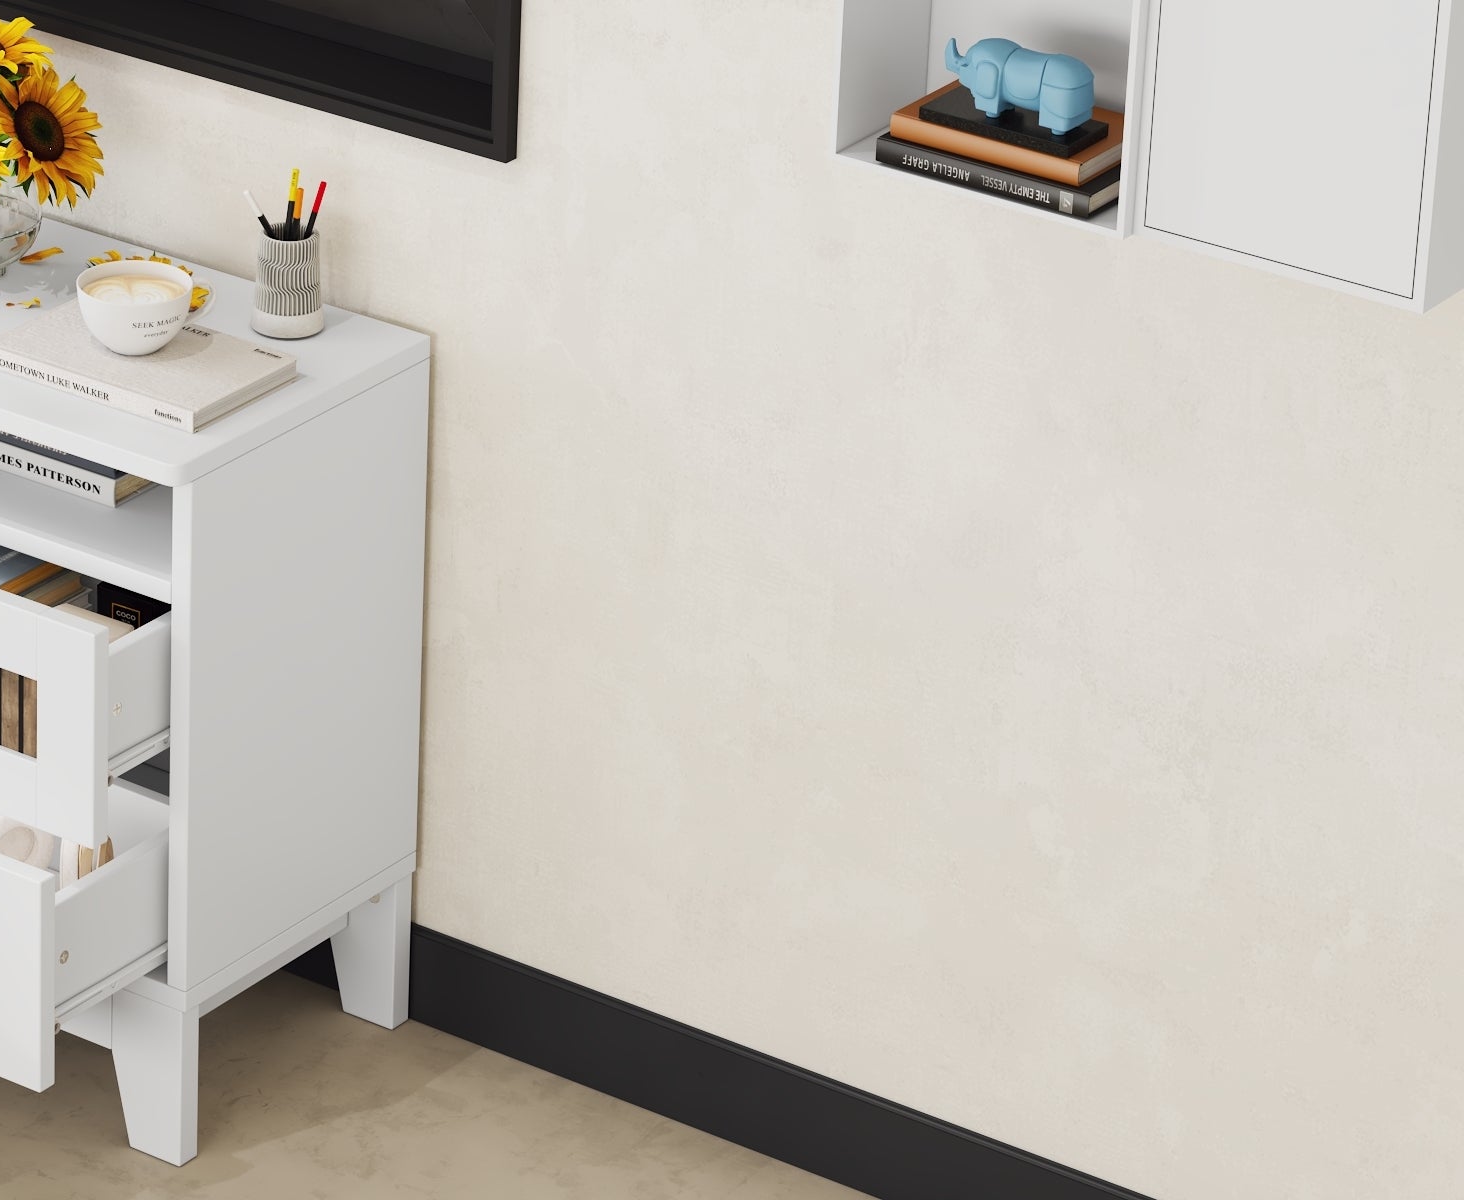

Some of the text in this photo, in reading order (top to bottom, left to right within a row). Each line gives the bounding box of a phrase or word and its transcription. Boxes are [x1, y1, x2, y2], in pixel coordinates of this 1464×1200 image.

[902, 153, 1051, 204] THE EMPTY VESSEL ANGELLA GRAFF
[47, 374, 71, 389] LUKE
[72, 382, 110, 401] WALKER
[154, 409, 182, 423] functions
[26, 462, 102, 495] PATTERSON
[115, 610, 137, 621] COCO
